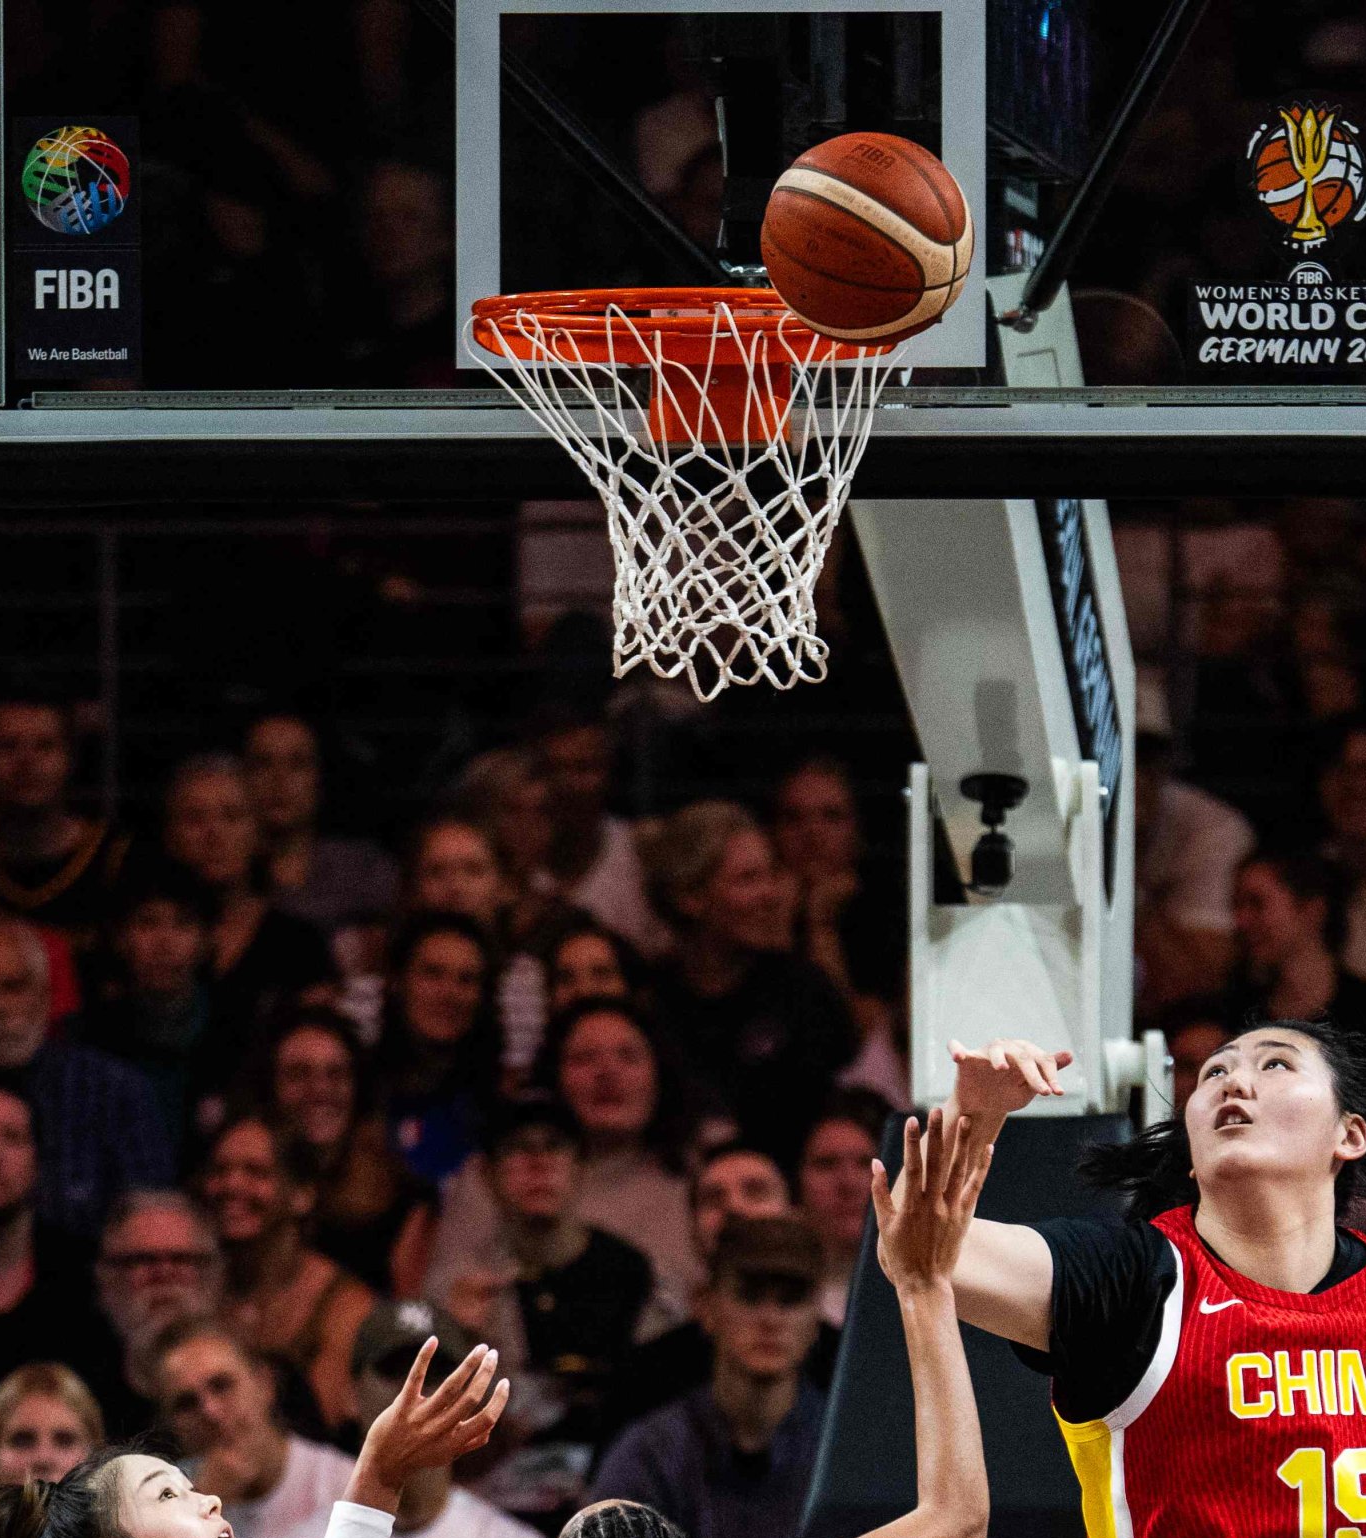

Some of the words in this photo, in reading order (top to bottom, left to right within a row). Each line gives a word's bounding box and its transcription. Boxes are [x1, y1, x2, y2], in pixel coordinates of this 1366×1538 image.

[1297, 271, 1322, 284] FIBA
[35, 268, 119, 309] FIBA
[1196, 285, 1290, 300] WOMEN'S
[1199, 302, 1336, 330] WORLD
[28, 348, 47, 360] We
[49, 348, 70, 360] Are
[72, 347, 128, 360] Basketball
[1199, 336, 1340, 364] GERMANY
